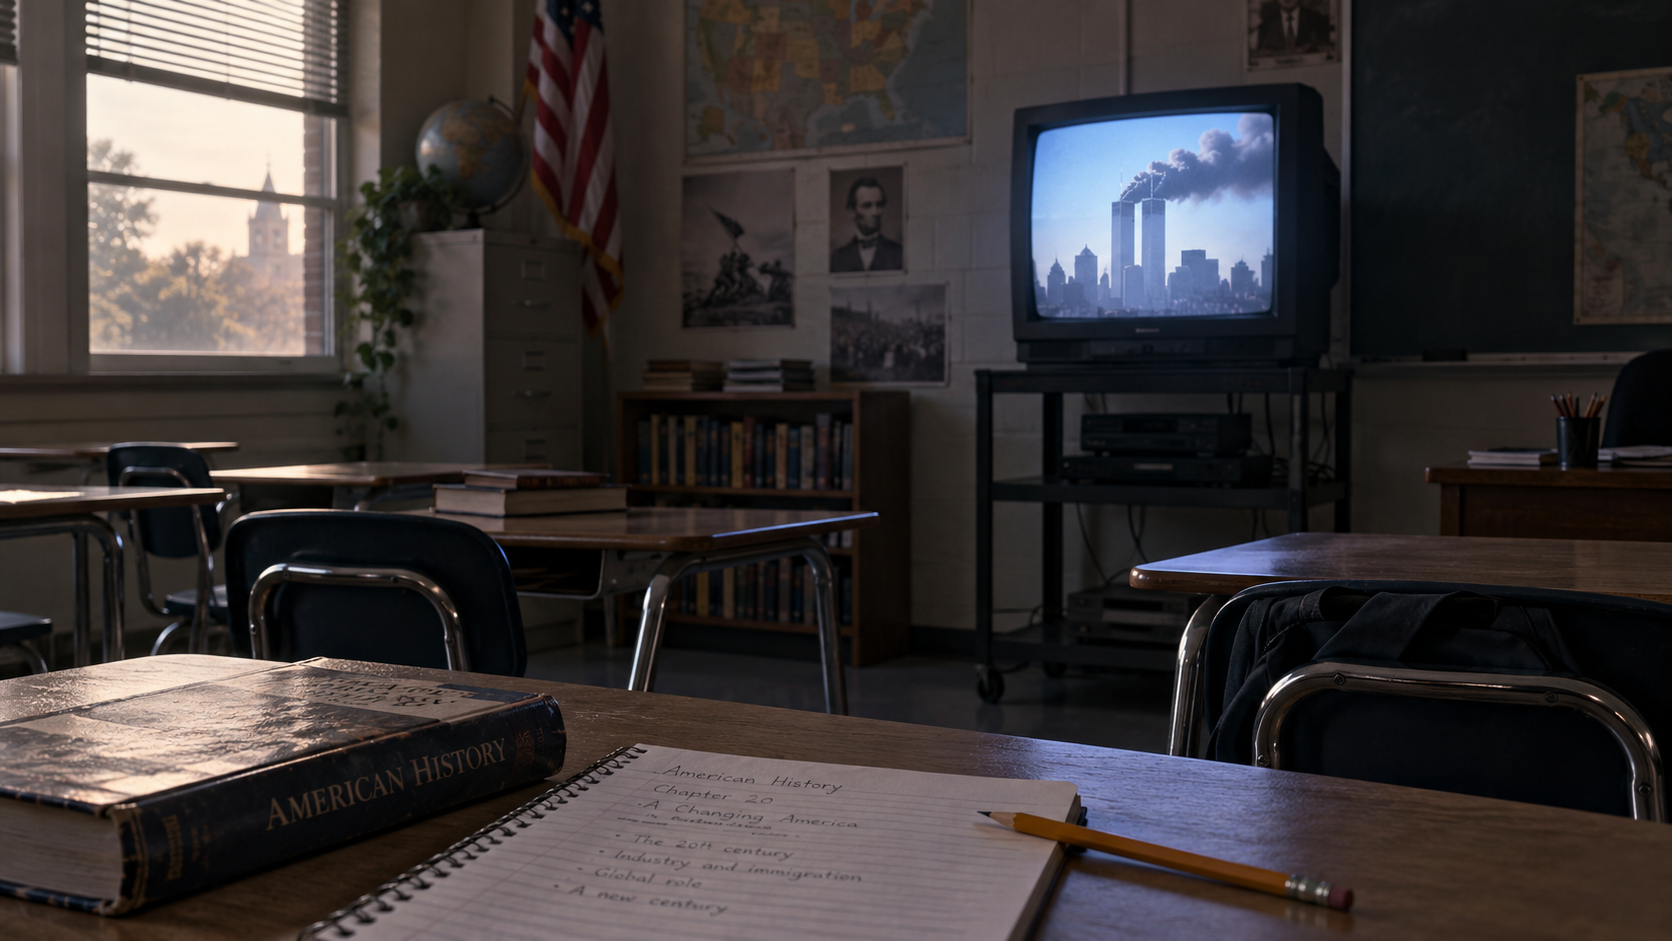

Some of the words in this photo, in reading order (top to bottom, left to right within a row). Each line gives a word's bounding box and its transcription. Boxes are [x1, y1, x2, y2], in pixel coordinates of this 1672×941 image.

[266, 767, 405, 831] AMERICAN
[410, 738, 507, 787] HISTORY
[662, 765, 755, 785] American
[771, 776, 843, 794] History
[654, 784, 733, 801] Chapter
[745, 794, 773, 804] 20
[643, 800, 660, 810] A
[674, 804, 764, 822] Changing
[780, 814, 858, 828] America
[633, 834, 663, 847] The
[723, 845, 794, 861] century
[595, 867, 656, 884] Global
[666, 877, 702, 889] role
[614, 849, 691, 869] Industry
[702, 861, 738, 873] and
[748, 863, 863, 882] immigration
[568, 885, 585, 896] A
[597, 890, 636, 903] new
[649, 895, 729, 916] century
